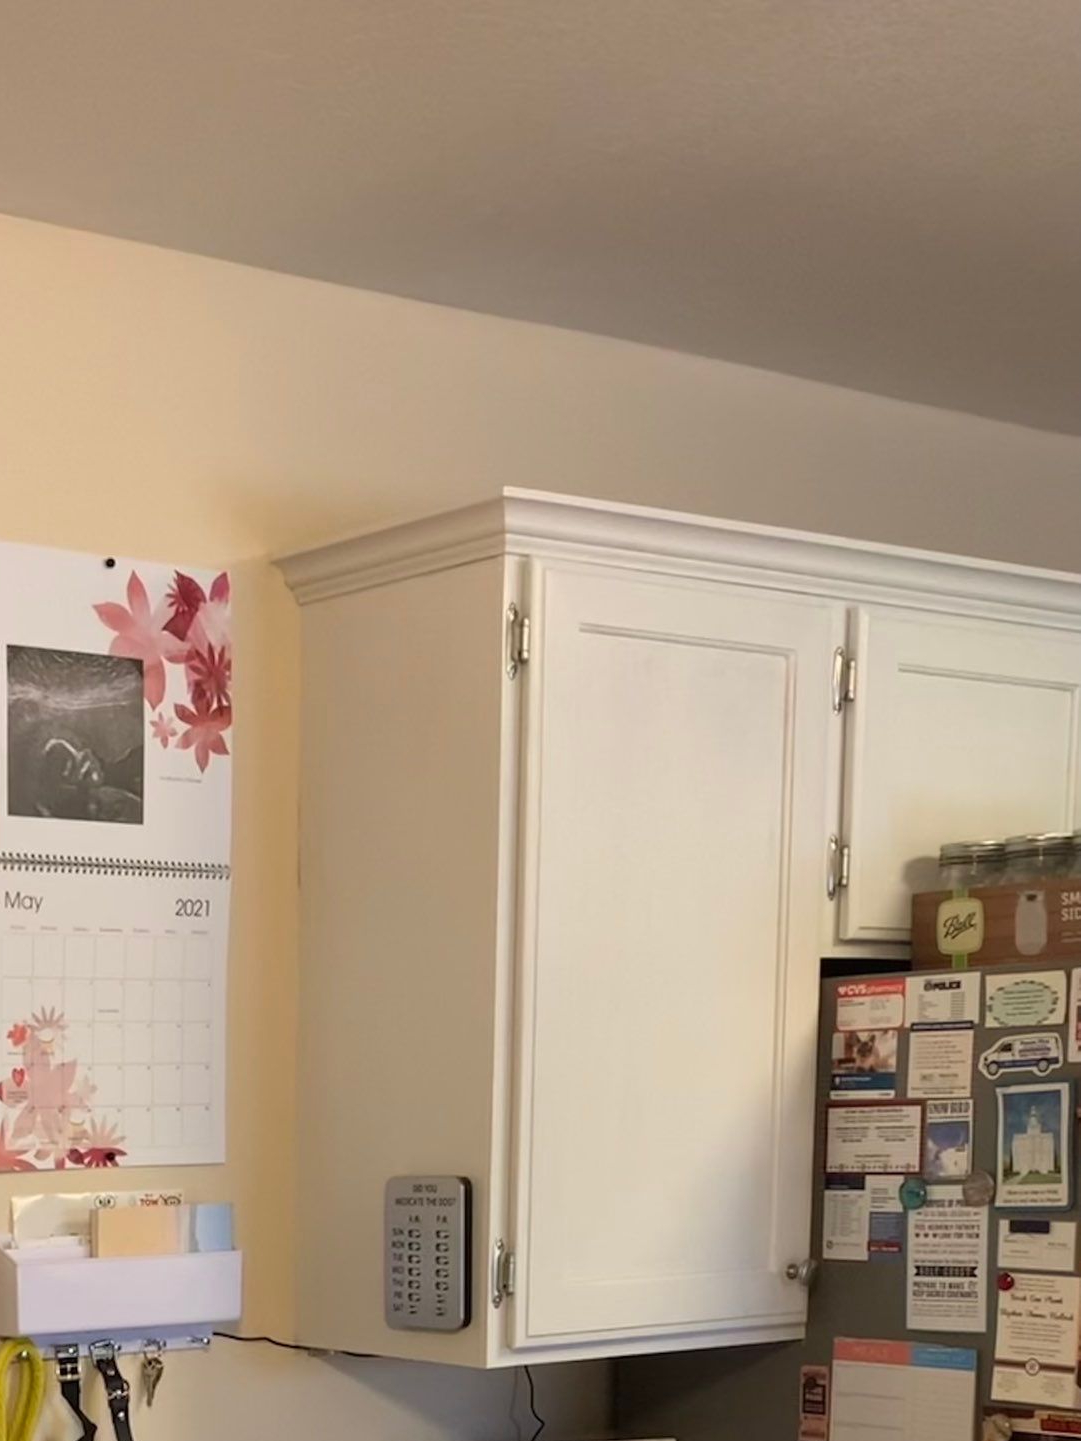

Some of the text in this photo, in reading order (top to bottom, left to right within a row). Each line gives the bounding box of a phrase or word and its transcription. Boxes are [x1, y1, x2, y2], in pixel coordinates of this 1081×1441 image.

[4, 891, 43, 913] May
[175, 898, 210, 917] 2021
[943, 912, 977, 940] Ball
[847, 984, 867, 995] CVS
